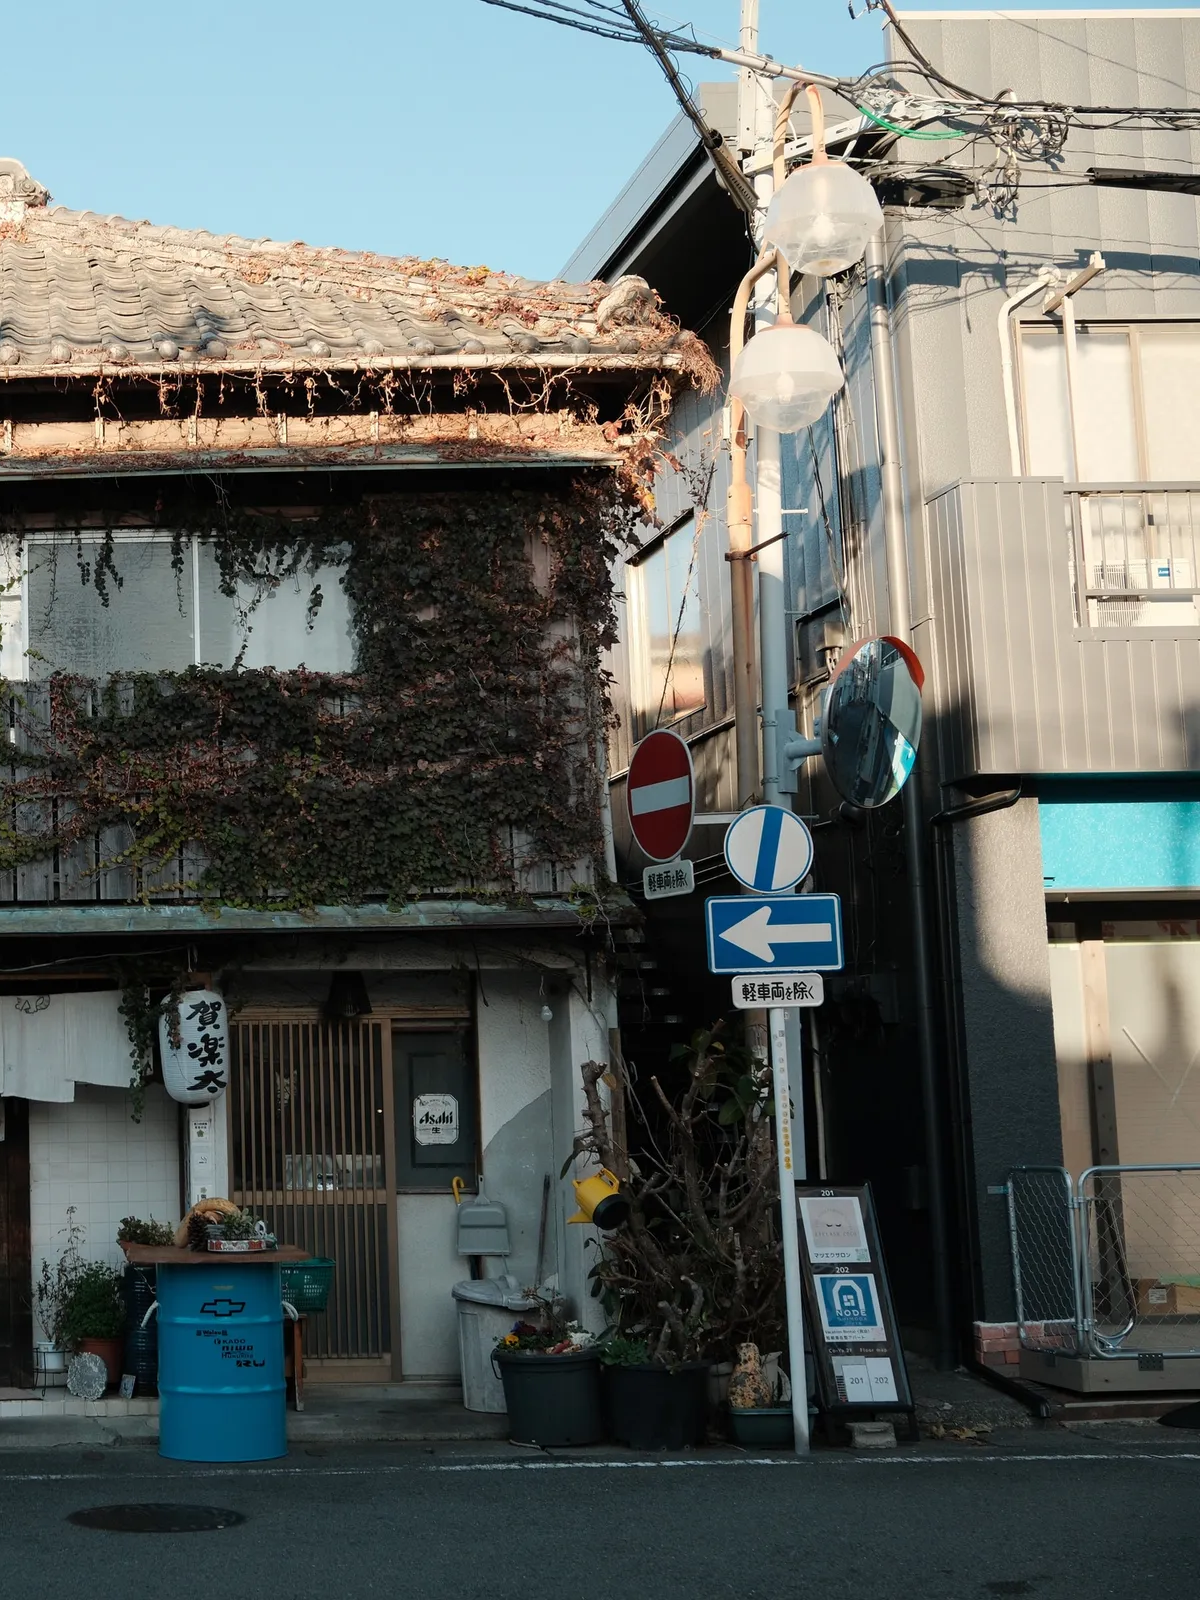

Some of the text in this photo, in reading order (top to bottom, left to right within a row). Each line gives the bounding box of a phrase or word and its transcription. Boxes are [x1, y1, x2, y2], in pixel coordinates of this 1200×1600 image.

[647, 869, 688, 892] 軽車両を除く
[741, 981, 814, 1002] 軽車両を除く
[186, 1000, 227, 1094] 賀楽太
[419, 1110, 453, 1125] Asahi
[835, 1309, 867, 1317] NODE
[850, 1377, 889, 1385] 201 202
